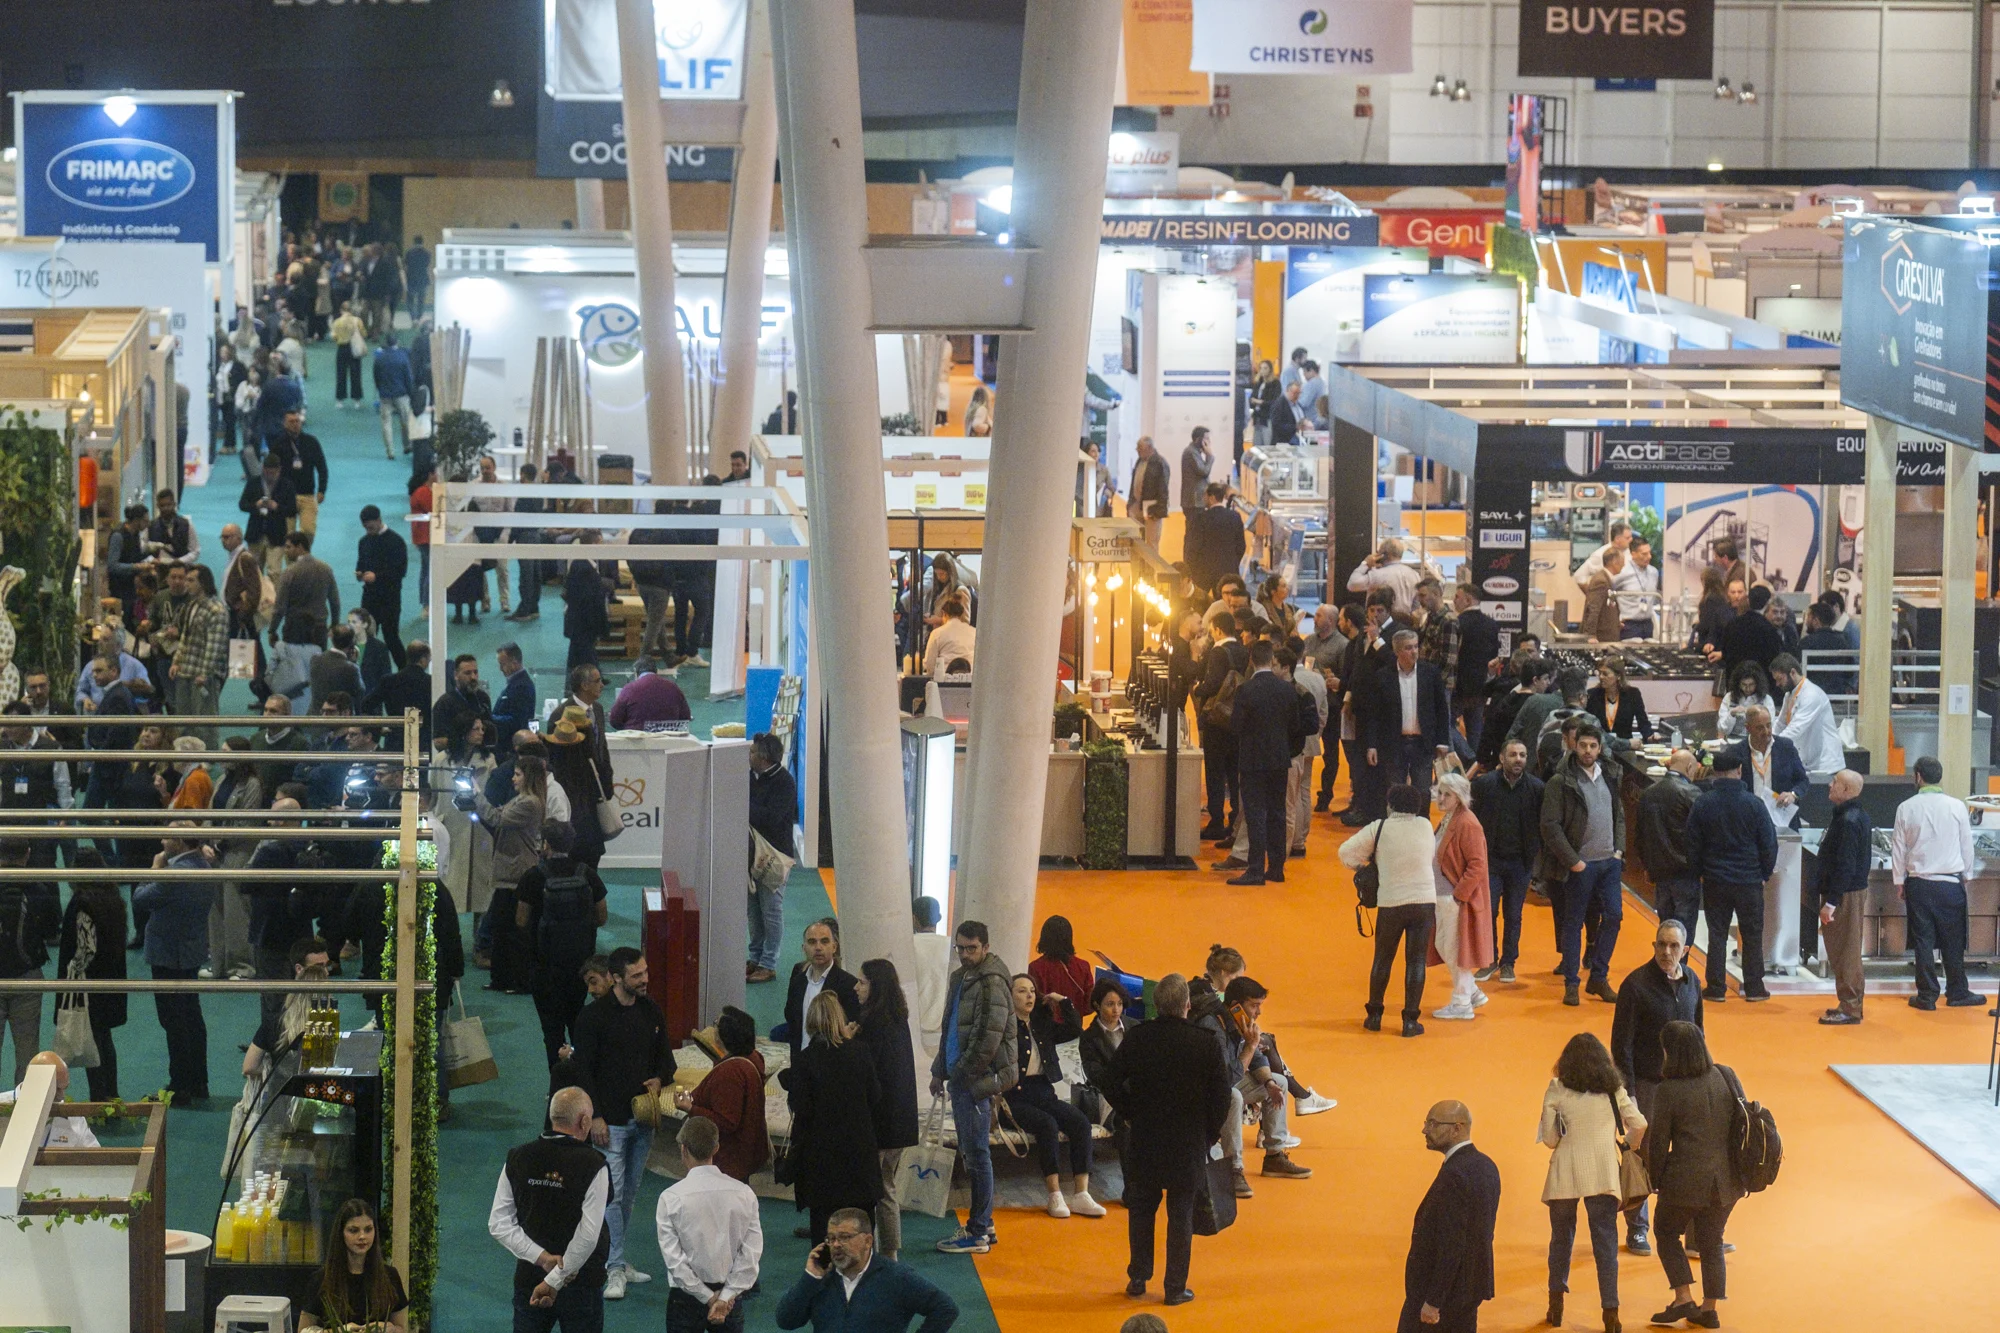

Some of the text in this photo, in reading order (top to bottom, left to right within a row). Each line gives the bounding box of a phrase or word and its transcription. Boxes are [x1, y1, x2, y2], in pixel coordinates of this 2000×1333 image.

[1545, 6, 1687, 36] BUYERS
[1250, 47, 1374, 63] CHRISTEYNS
[569, 140, 706, 166] COONG
[66, 159, 174, 181] FRIMARC
[62, 223, 180, 235] Indústria & Comércio
[1101, 220, 1154, 239] MAPEI
[1165, 221, 1350, 240] RESINFLOORING
[15, 269, 99, 288] T2 TRADING
[1895, 257, 1944, 307] GRESILVA
[1480, 511, 1512, 520] SAYL
[1087, 535, 1119, 548] Gard
[1495, 532, 1522, 542] UGUR
[620, 806, 660, 828] eal
